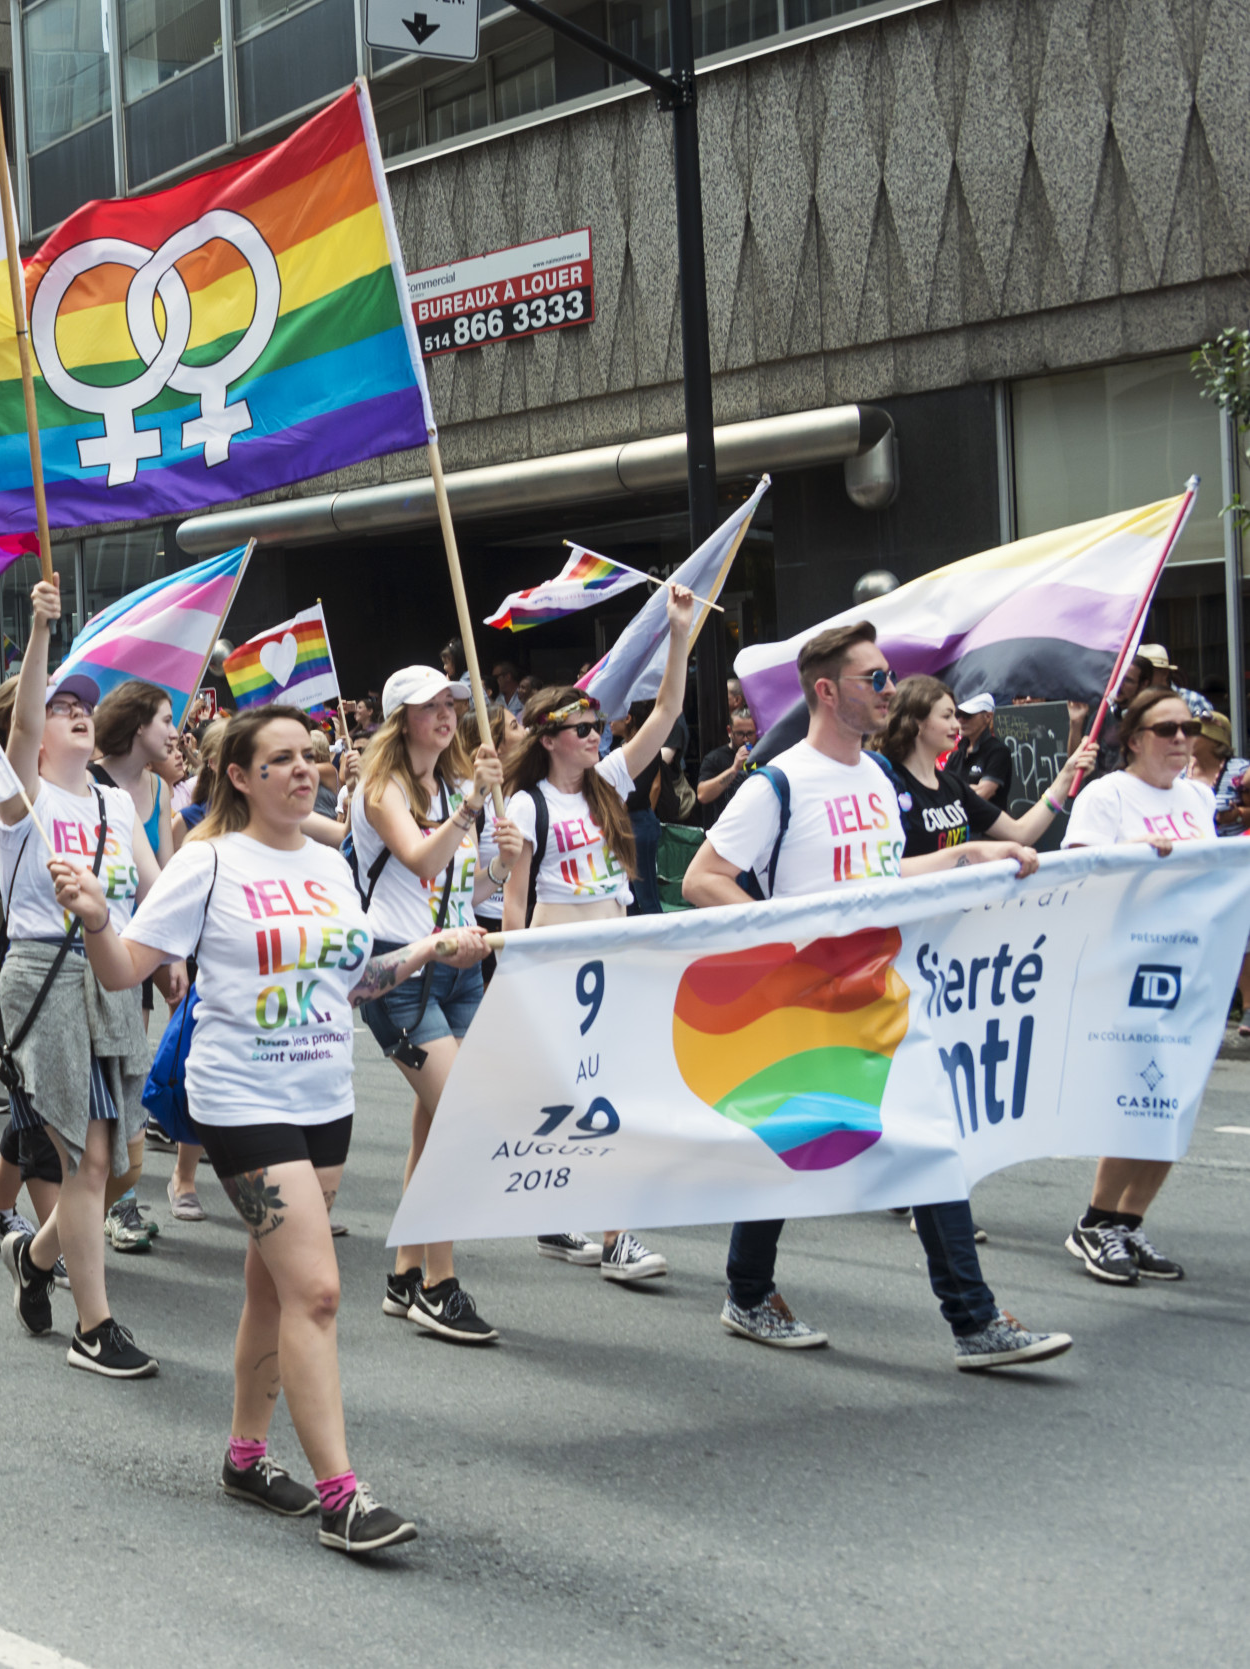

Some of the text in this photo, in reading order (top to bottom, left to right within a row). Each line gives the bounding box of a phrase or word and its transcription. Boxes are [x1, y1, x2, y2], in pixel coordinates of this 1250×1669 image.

[418, 265, 583, 322] BUREAUX À LOUER
[424, 289, 584, 352] 514 866 3333
[823, 792, 891, 837] IELS
[1142, 810, 1207, 842] IELS
[53, 818, 122, 857] IELS
[833, 840, 904, 883] ILLES
[241, 879, 340, 920] IELS
[255, 926, 369, 977] ILLES
[1179, 933, 1200, 946] PAR
[575, 959, 605, 1037] 9
[1137, 971, 1179, 1002] TD
[255, 979, 332, 1030] O.K.
[291, 1035, 310, 1047] les
[1088, 1031, 1100, 1042] EN
[252, 1048, 334, 1063] sont valides.
[576, 1052, 600, 1085] AU
[1116, 1095, 1179, 1110] CASINO
[1124, 1110, 1175, 1120] MONTRÉAL
[491, 1140, 617, 1161] AUGUST
[504, 1166, 572, 1194] 2018
